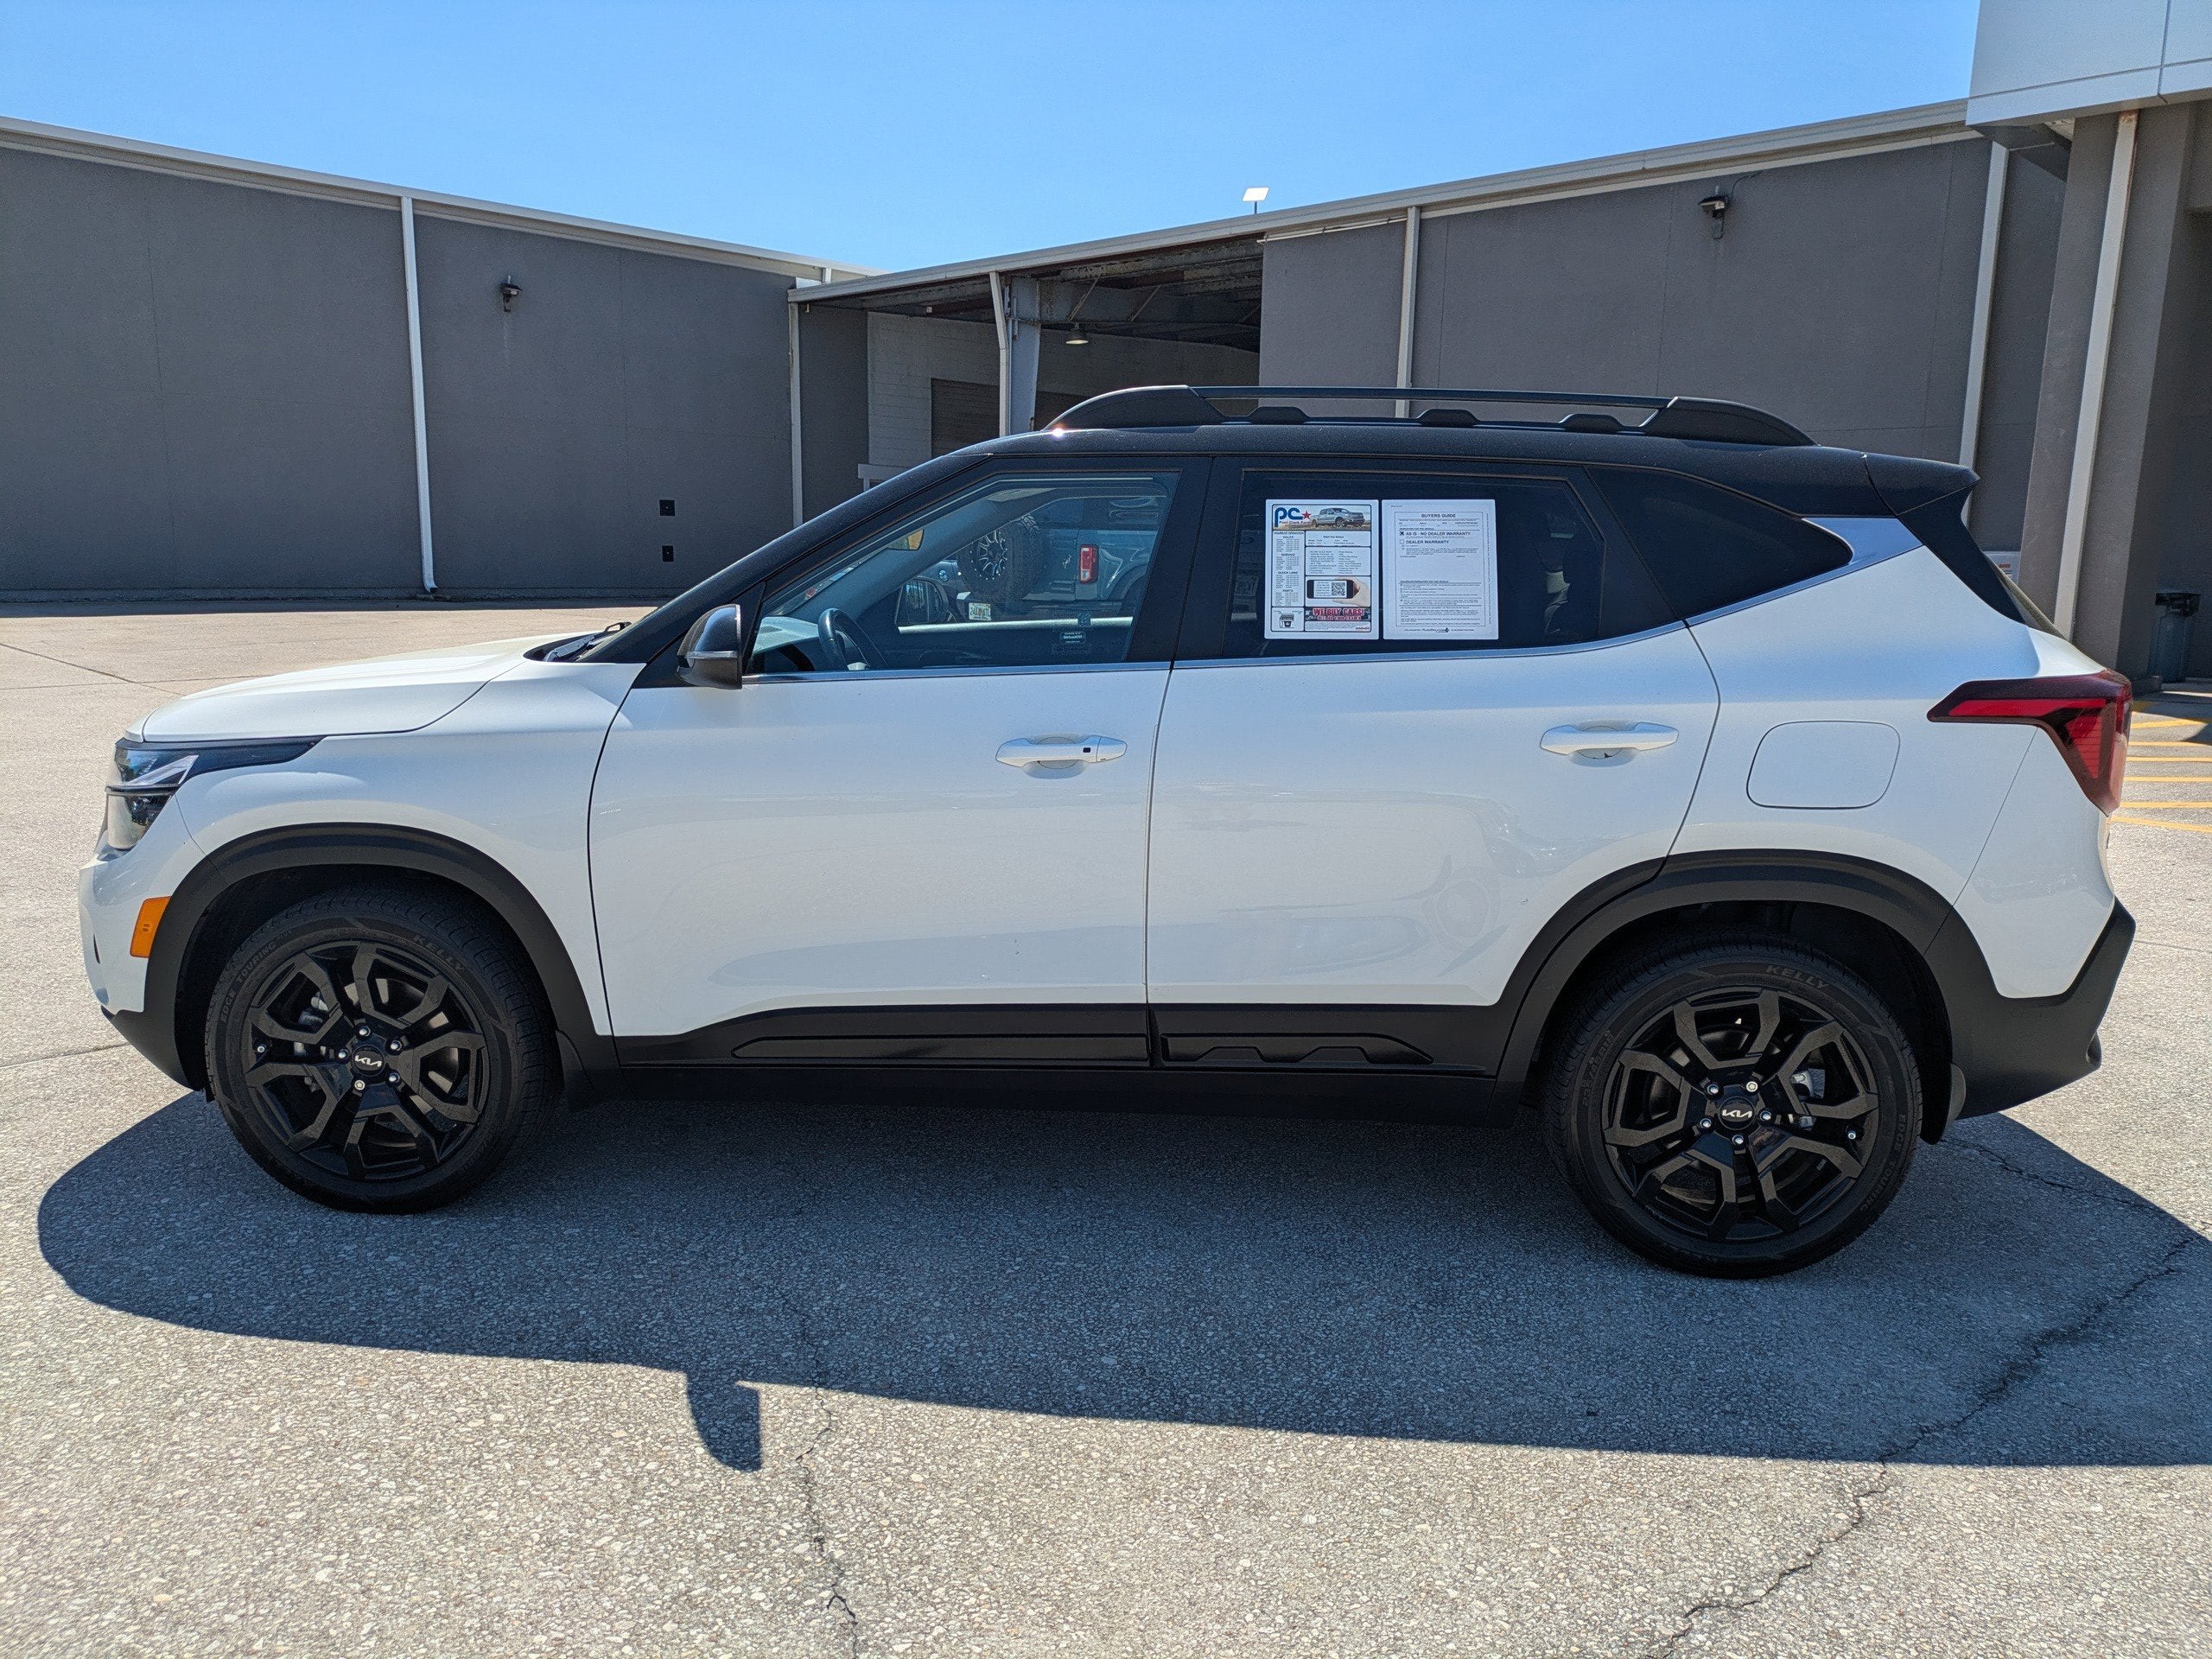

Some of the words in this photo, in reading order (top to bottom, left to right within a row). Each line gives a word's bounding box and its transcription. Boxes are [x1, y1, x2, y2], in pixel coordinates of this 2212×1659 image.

[413, 934, 467, 975] KELLY
[219, 988, 237, 1023] EDGE
[235, 942, 276, 982] TOURING
[1765, 965, 1829, 989] KELLY
